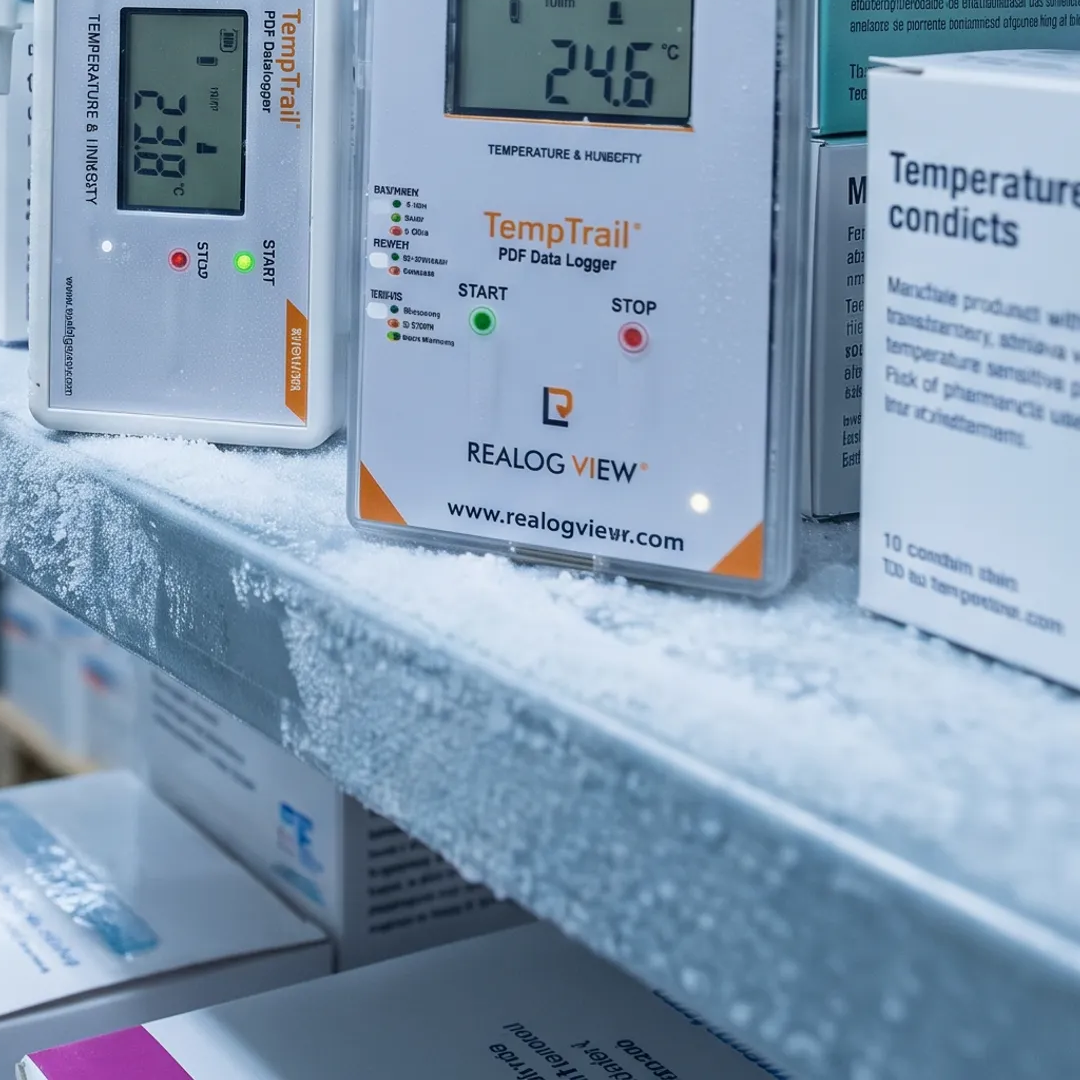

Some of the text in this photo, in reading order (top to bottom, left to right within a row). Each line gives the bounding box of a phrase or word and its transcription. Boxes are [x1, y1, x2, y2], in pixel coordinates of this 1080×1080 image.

[264, 10, 276, 37] PDF
[86, 14, 101, 119] TEMPERATURE
[545, 39, 654, 108] 24.6
[134, 90, 186, 179] 23.8
[488, 144, 570, 160] TEMPERATURE
[573, 149, 582, 161] &
[889, 204, 1019, 249] condicts
[263, 240, 276, 286] START
[498, 247, 617, 273] PDF Data Logger
[458, 283, 508, 301] START
[612, 297, 657, 316] STOP
[467, 441, 565, 475] REALOG
